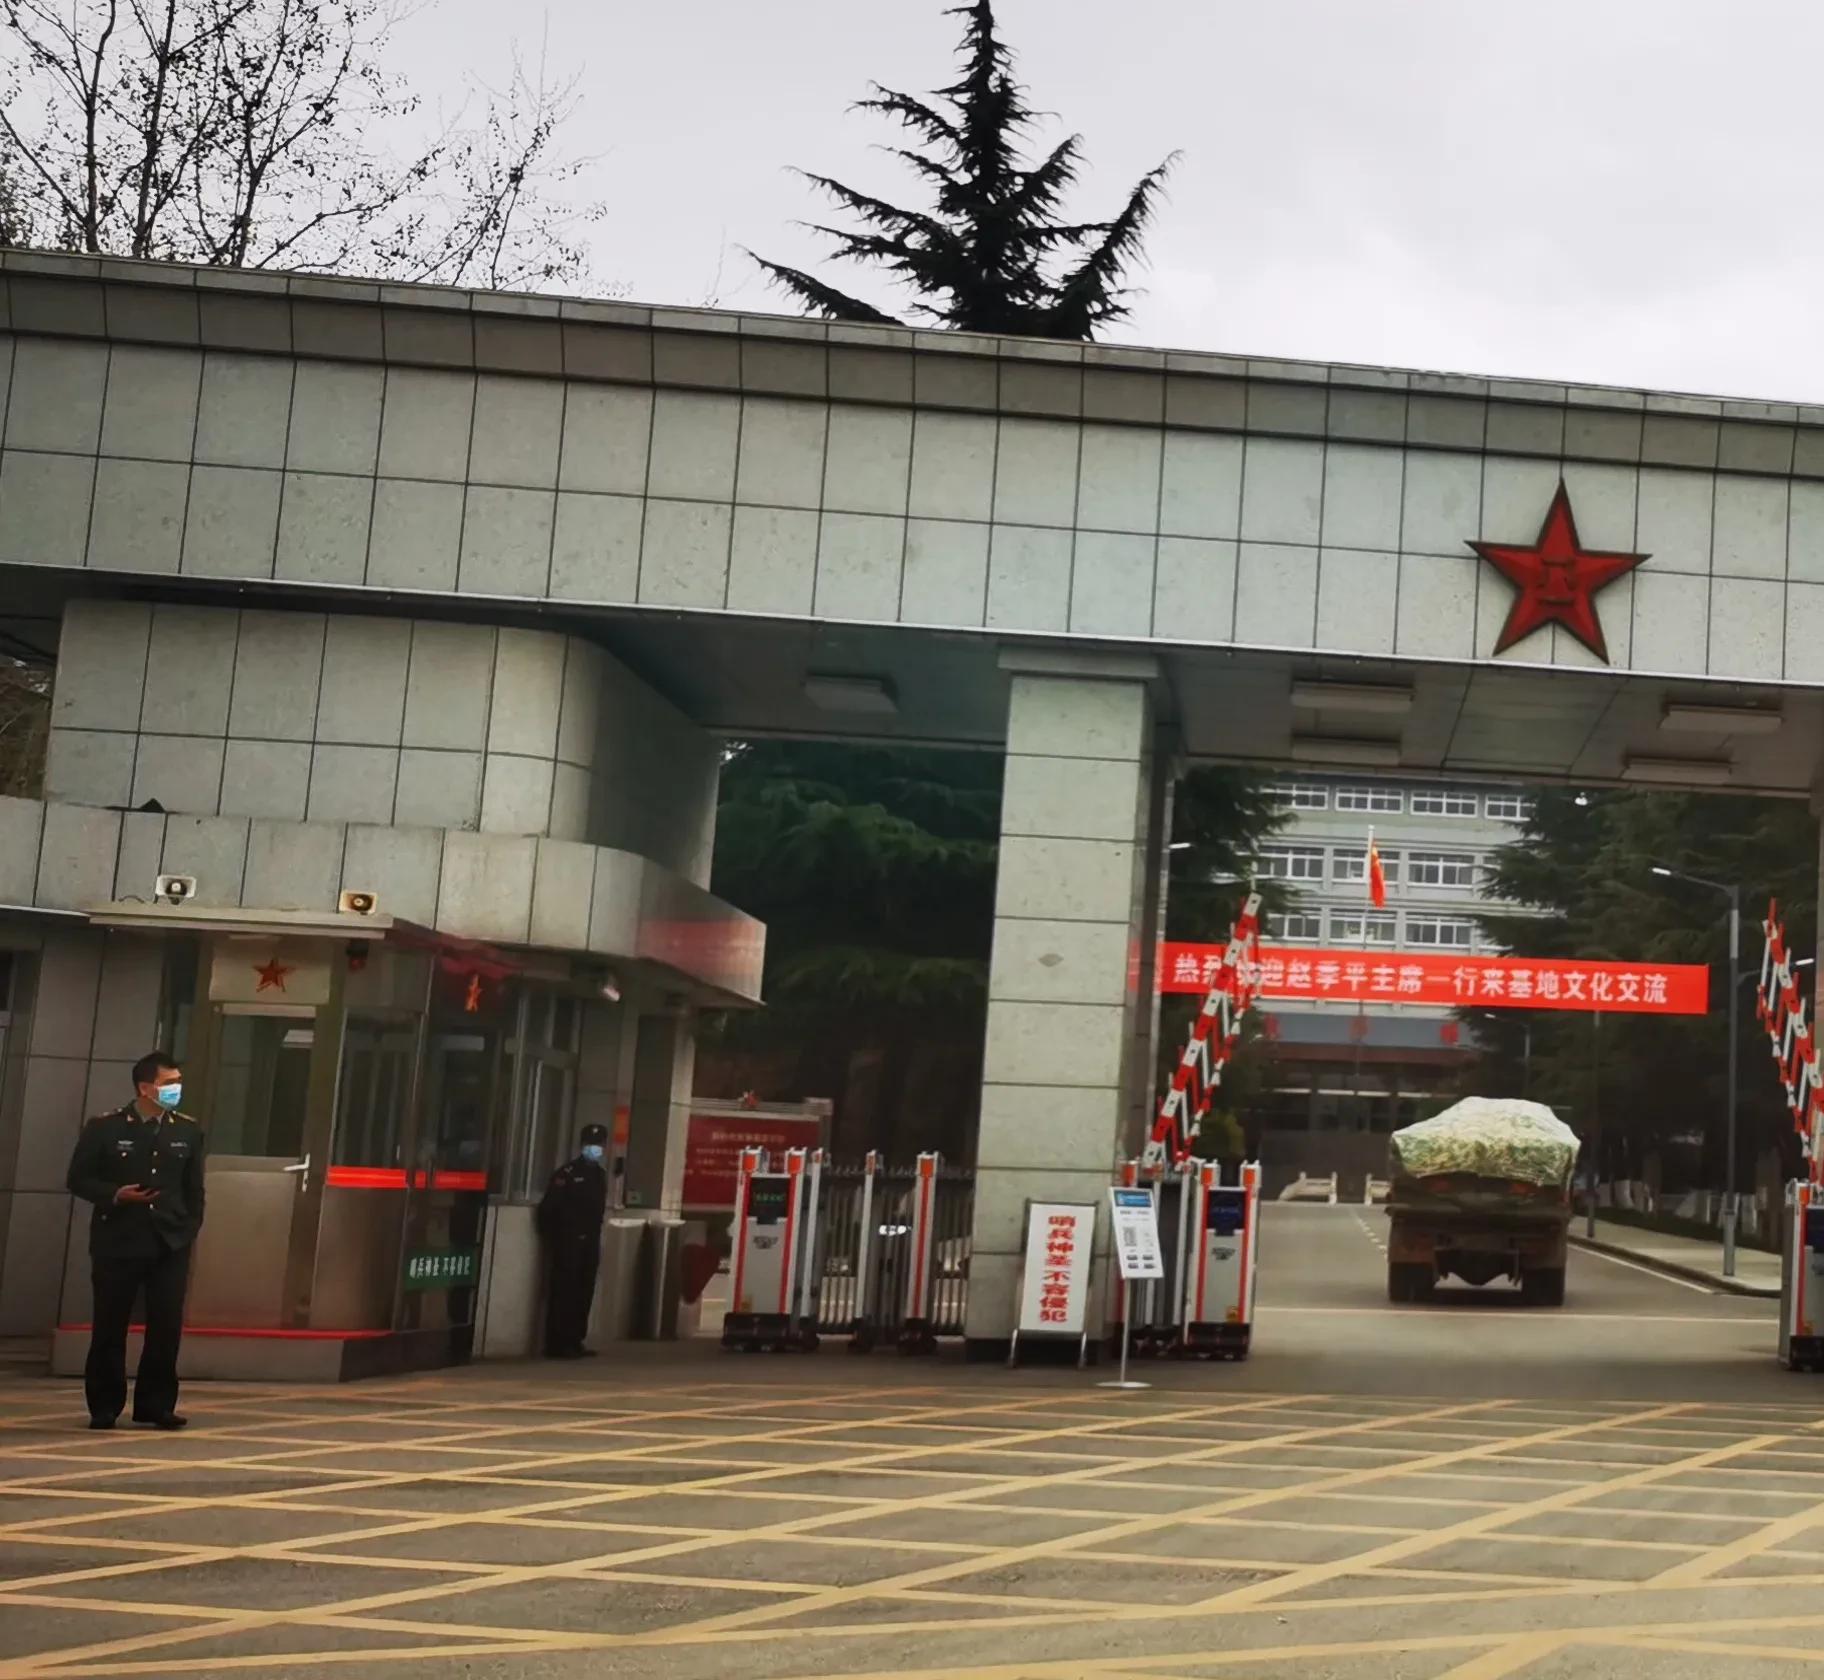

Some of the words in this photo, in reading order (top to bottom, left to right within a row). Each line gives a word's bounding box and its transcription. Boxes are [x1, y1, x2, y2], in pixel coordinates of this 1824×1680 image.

[1038, 1214, 1077, 1323] 哨兵神圣不容侵犯
